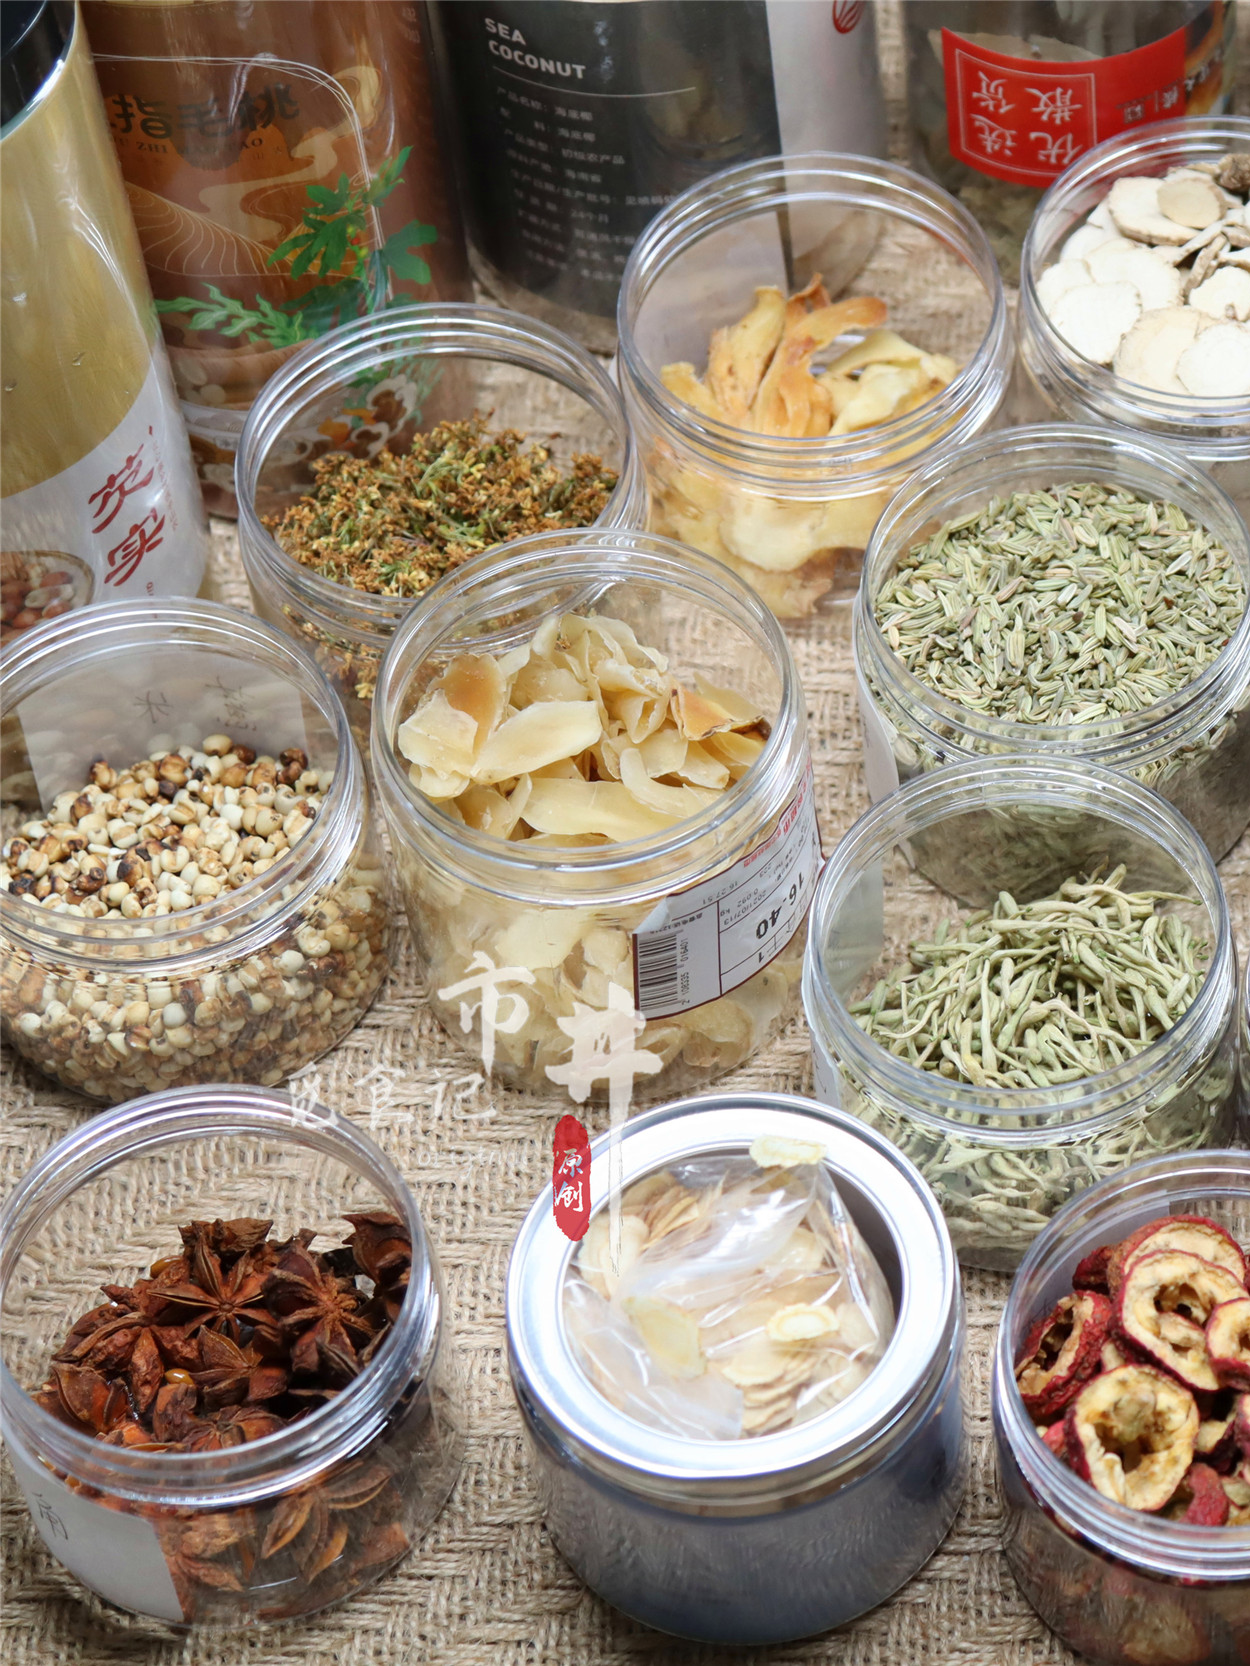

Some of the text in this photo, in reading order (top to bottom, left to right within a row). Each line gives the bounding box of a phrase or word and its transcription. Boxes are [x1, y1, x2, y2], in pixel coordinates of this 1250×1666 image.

[485, 17, 527, 46] SEA
[488, 39, 587, 80] COCONUT
[108, 82, 301, 140] 指毛桃
[971, 71, 1083, 125] 散货
[970, 114, 1084, 165] 优选
[88, 443, 165, 588] 芡实
[755, 871, 806, 940] 16.40
